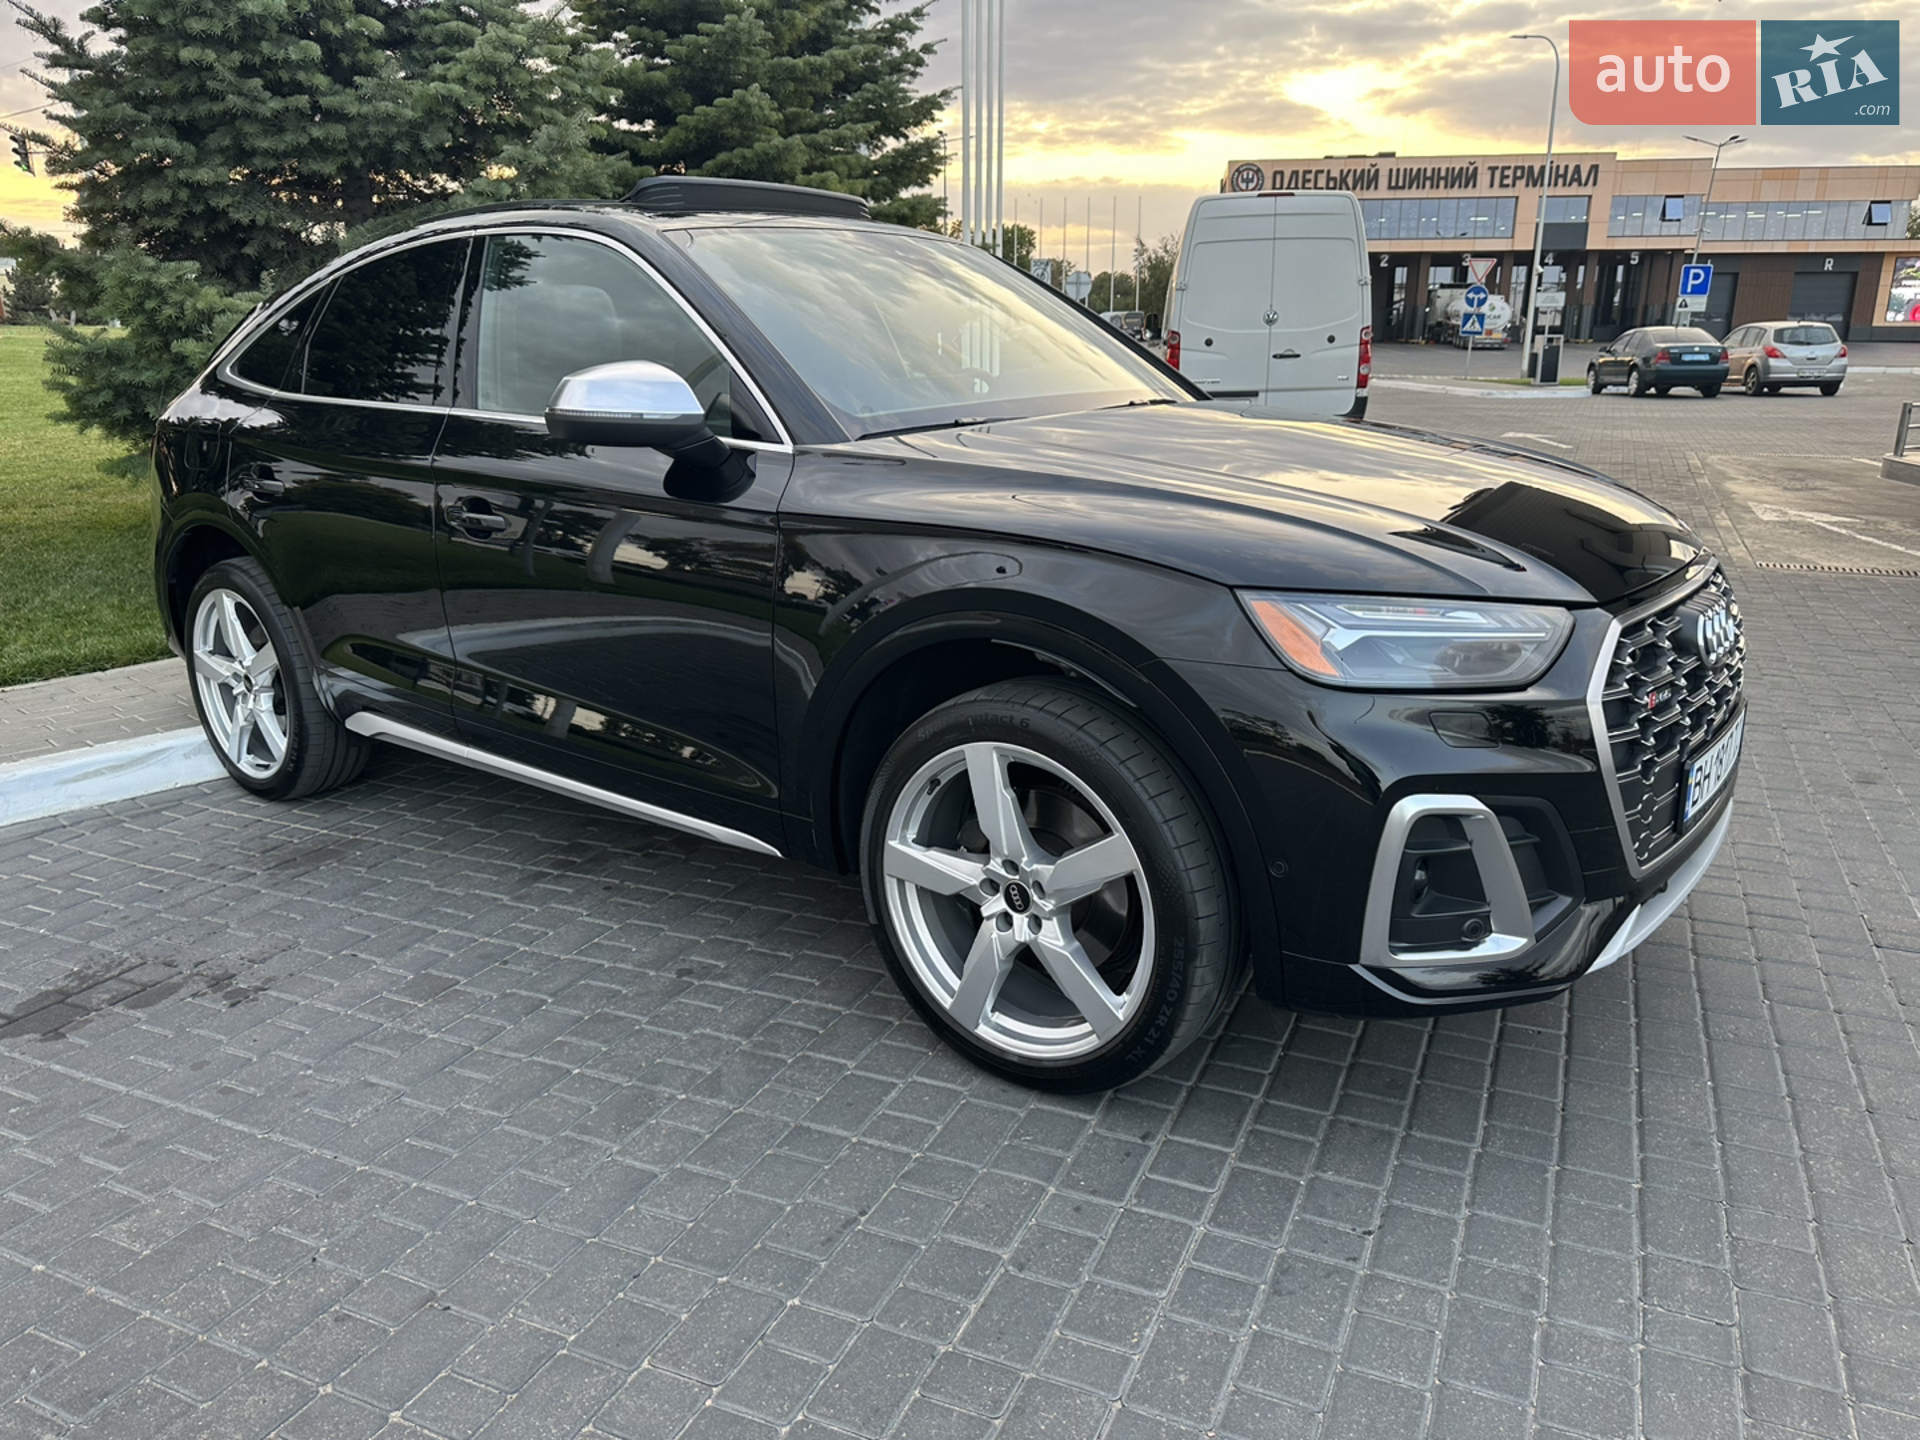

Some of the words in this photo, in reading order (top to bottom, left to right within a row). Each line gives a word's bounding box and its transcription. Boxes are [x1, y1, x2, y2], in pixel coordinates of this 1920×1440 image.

[1271, 163, 1380, 191] ОДЕСЬКИЙ
[1387, 161, 1478, 190] ШИННИЙ
[1487, 160, 1600, 189] ТЕРМІНАЛ
[1379, 254, 1389, 267] 2
[1461, 253, 1471, 266] 3
[1544, 252, 1554, 265] 4
[1629, 251, 1639, 265] 5
[1823, 257, 1834, 271] R
[1686, 268, 1705, 293] P
[1019, 717, 1031, 729] 6
[1166, 936, 1185, 1003] 255/40
